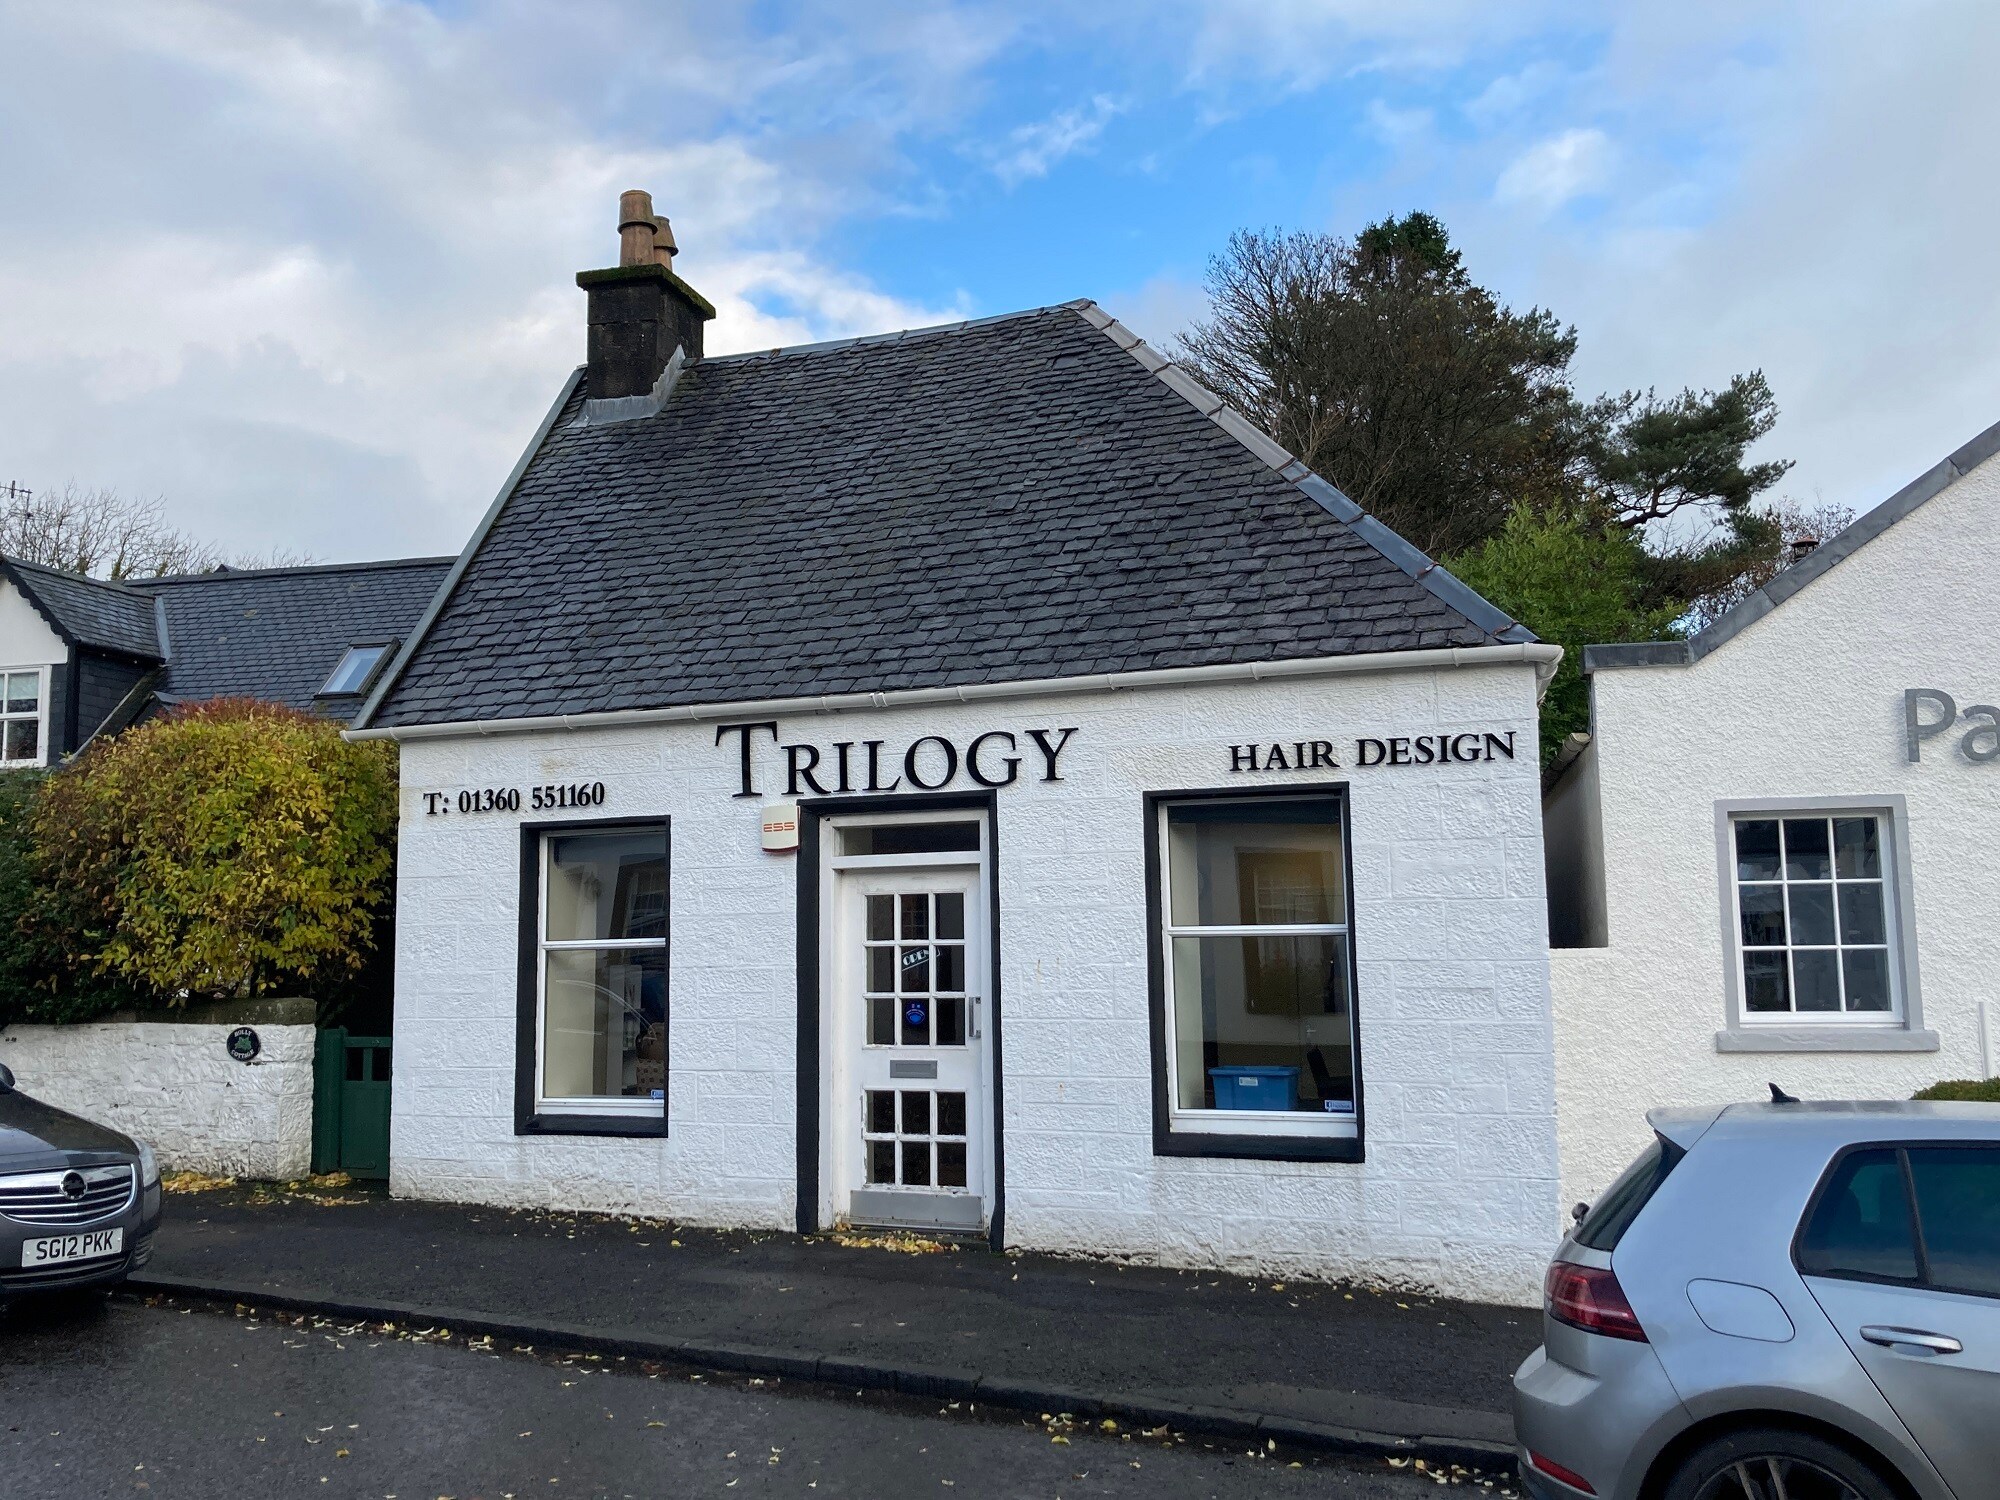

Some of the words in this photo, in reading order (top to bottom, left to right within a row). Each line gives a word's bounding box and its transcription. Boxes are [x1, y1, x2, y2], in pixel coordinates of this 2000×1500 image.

[715, 721, 1079, 797] TRILOGY
[1228, 742, 1340, 771] HAIR
[1356, 731, 1517, 766] DESIGN
[423, 792, 449, 814] T:
[458, 788, 520, 812] 01360
[531, 782, 605, 809] 551160
[763, 822, 795, 832] ESS
[36, 1236, 78, 1260] SG12
[83, 1231, 113, 1254] PKK
